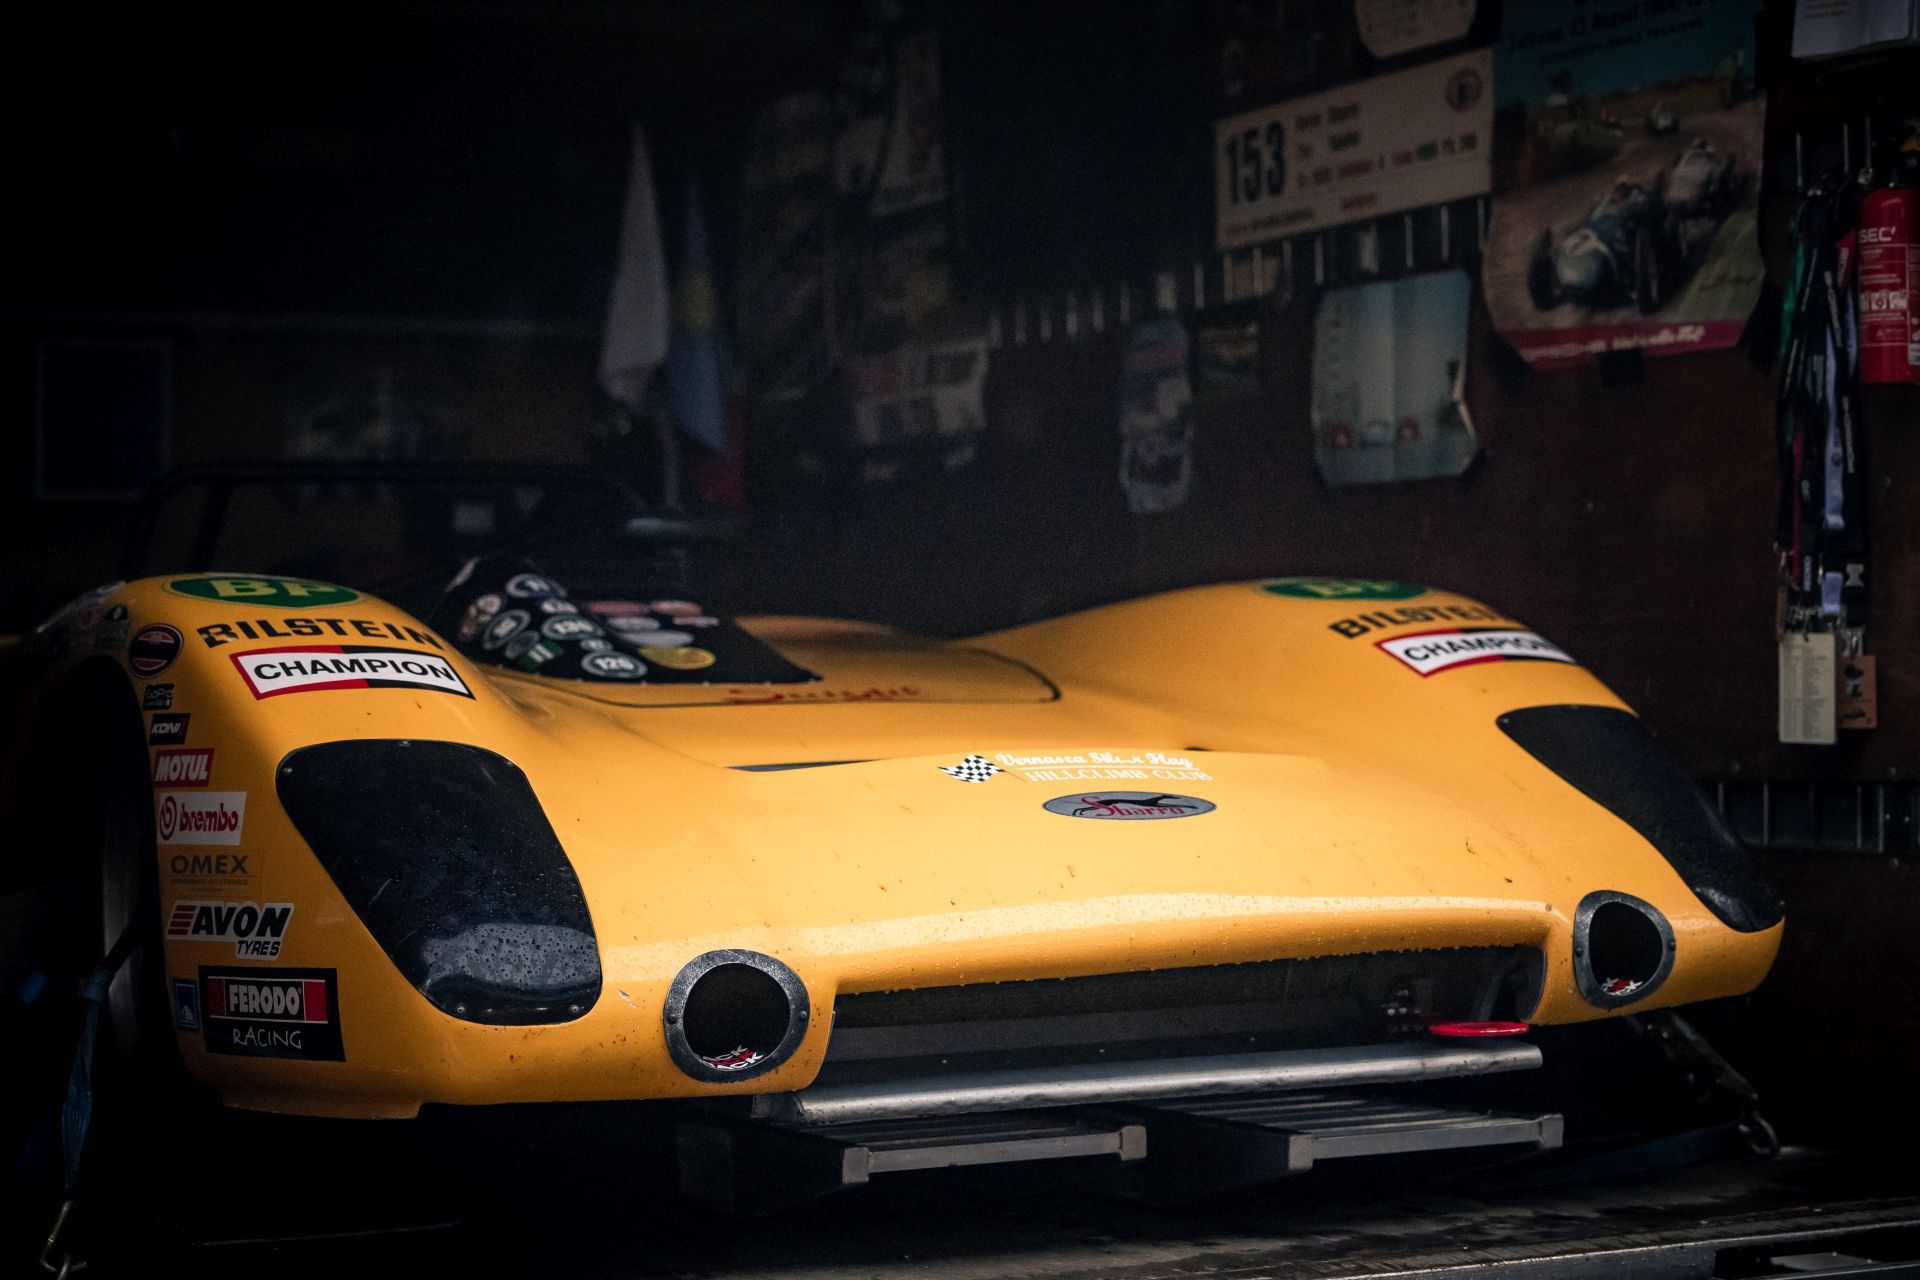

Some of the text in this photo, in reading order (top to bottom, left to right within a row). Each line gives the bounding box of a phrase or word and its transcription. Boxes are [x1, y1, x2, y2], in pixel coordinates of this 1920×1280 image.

[1226, 120, 1284, 205] 153
[211, 579, 337, 597] BP
[196, 618, 444, 650] BILSTEIN
[254, 658, 456, 681] CHAMPION
[151, 722, 182, 735] KONI
[155, 754, 209, 781] MOTUL
[996, 753, 1087, 766] Vernasca
[1023, 769, 1213, 782] HILLCLIMB CLUB
[180, 803, 239, 832] brembo
[1081, 796, 1185, 817] Sbarro
[171, 854, 249, 874] OMEX
[192, 906, 291, 937] AVON
[237, 940, 280, 956] TYRES
[229, 984, 301, 1015] FERODO
[233, 1027, 302, 1050] RACING
